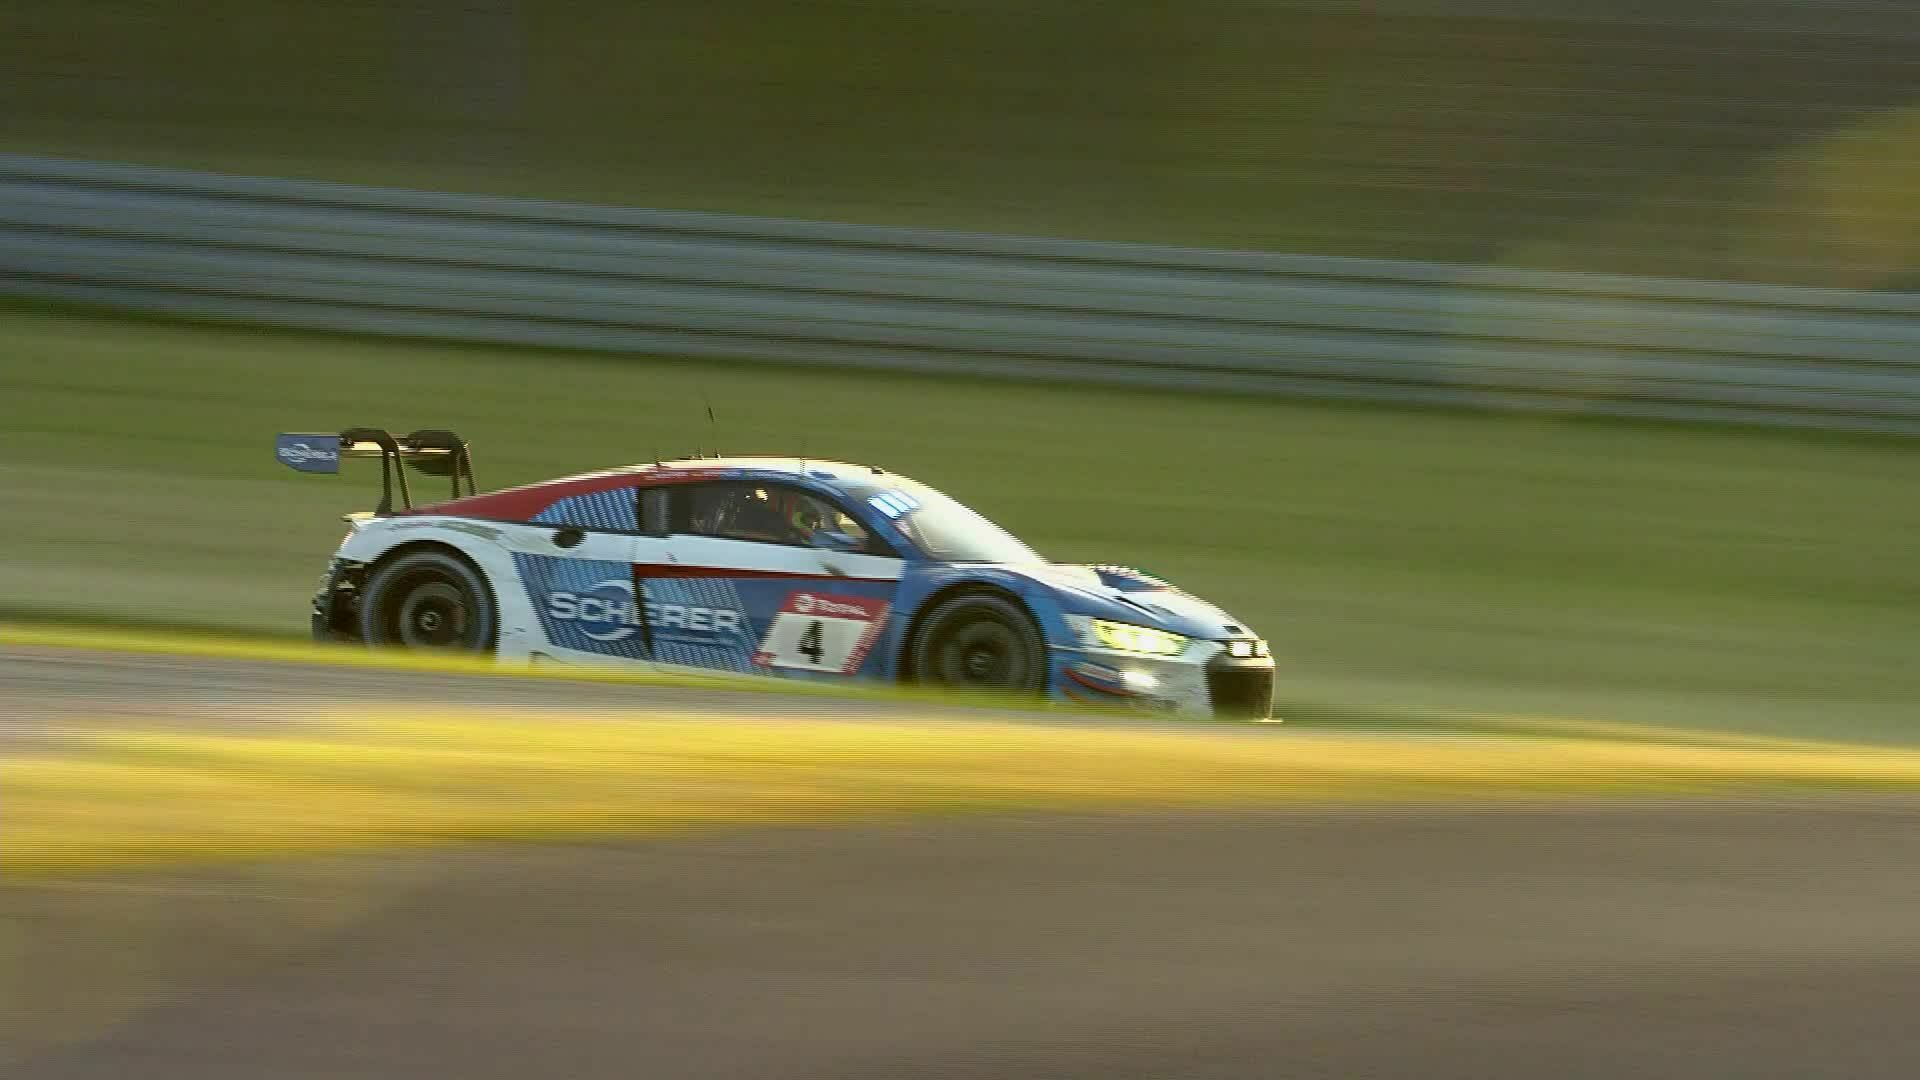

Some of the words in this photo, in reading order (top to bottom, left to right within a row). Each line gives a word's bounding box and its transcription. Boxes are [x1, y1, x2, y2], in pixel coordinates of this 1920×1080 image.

[547, 591, 744, 633] SCHERER
[814, 599, 871, 617] TOTAL
[797, 620, 825, 665] 4
